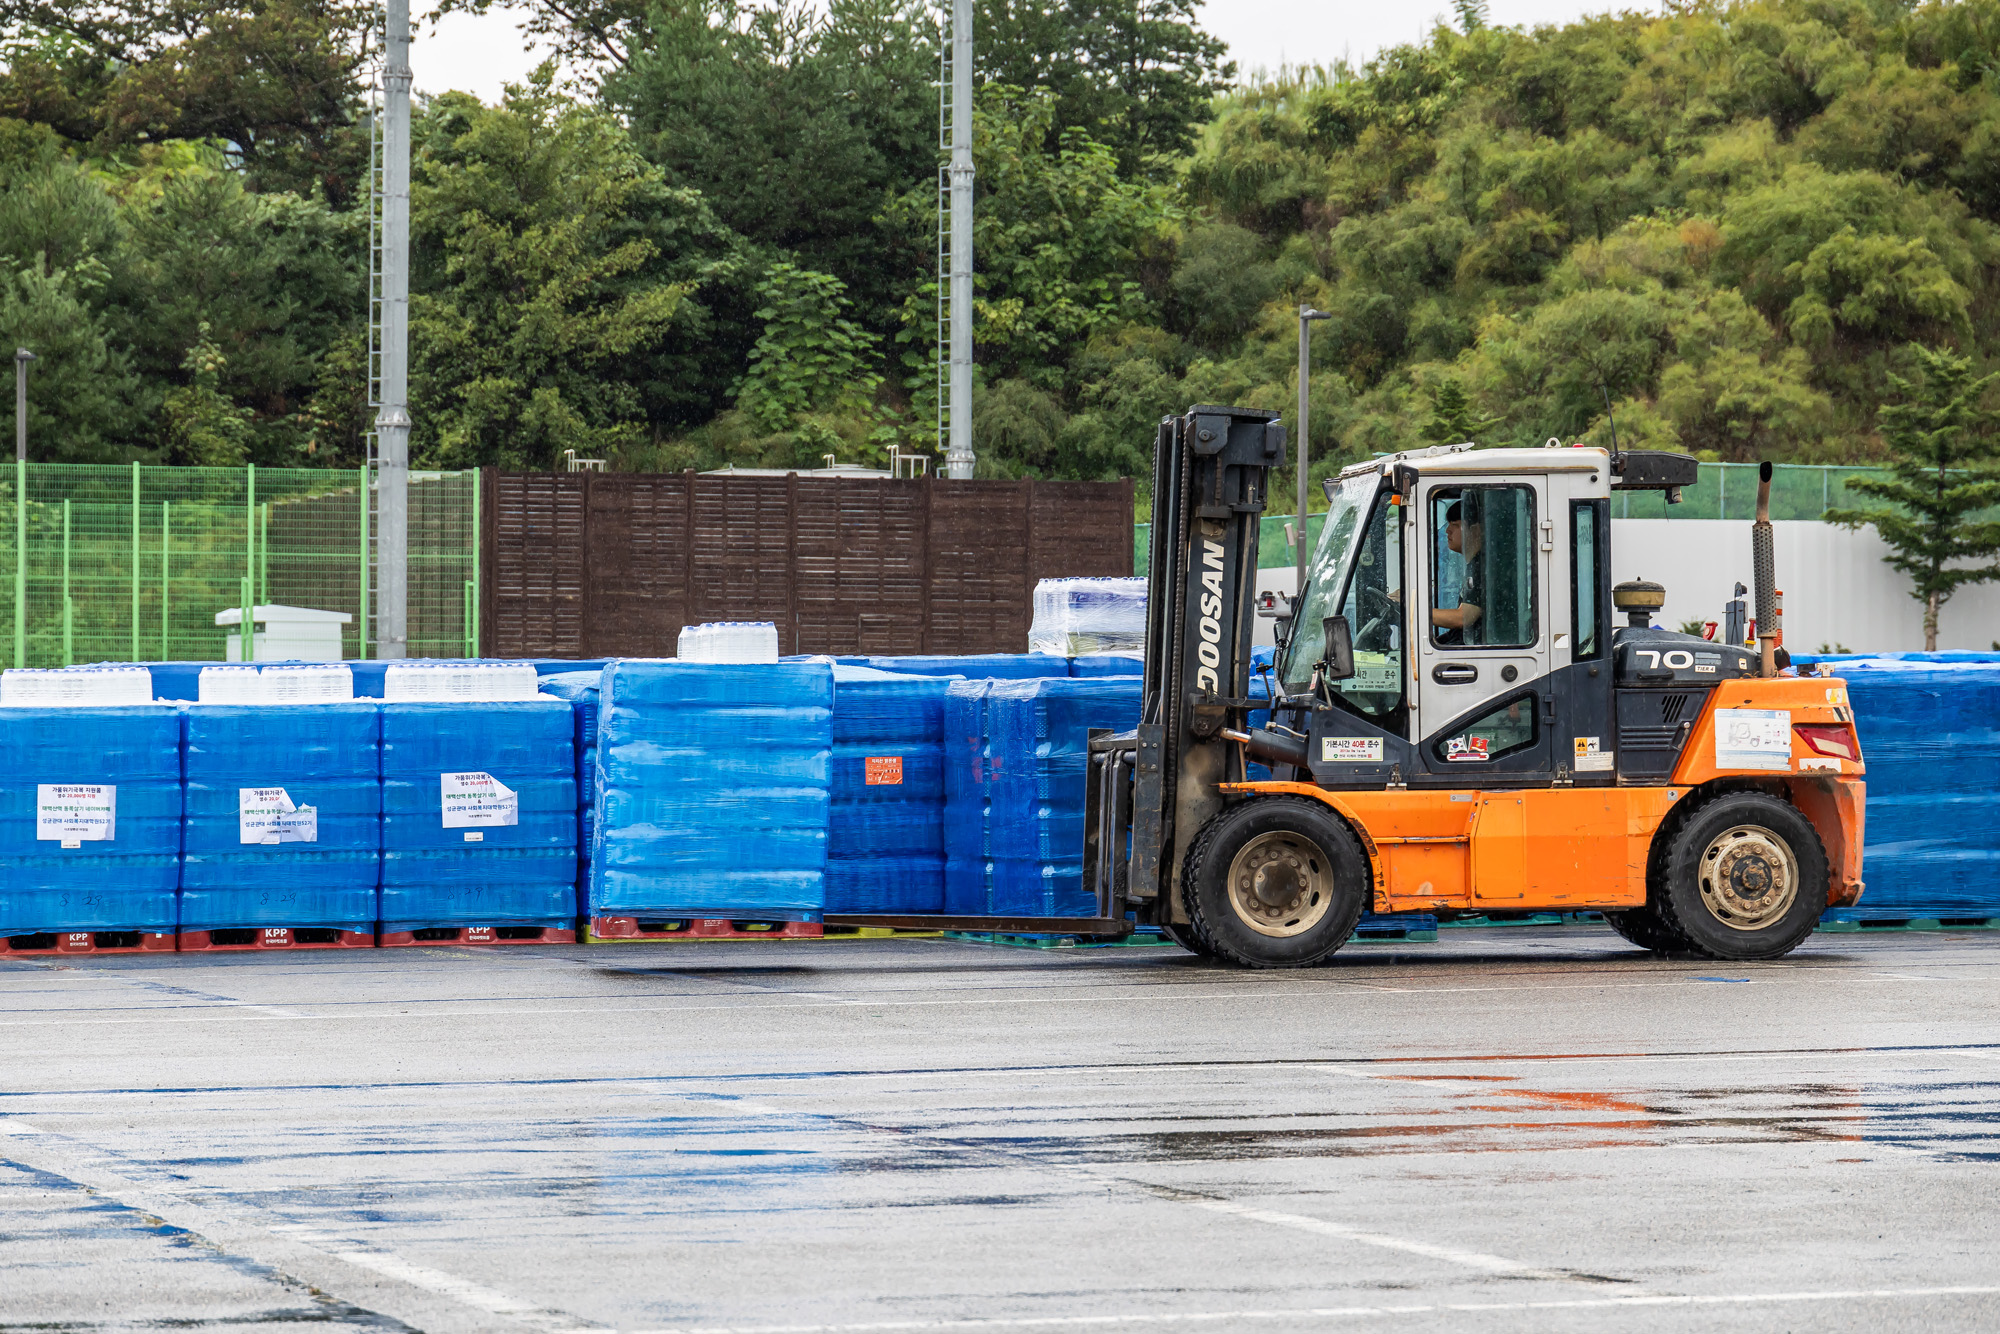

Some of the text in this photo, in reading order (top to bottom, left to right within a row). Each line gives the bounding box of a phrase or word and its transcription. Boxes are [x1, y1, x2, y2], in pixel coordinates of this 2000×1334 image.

[1197, 539, 1225, 695] DOOSAN
[1636, 650, 1694, 669] 70
[1384, 670, 1396, 679] 준수
[1326, 740, 1380, 748] 기본시간 40분 준수
[69, 933, 88, 941] KPP
[265, 928, 287, 937] KPP
